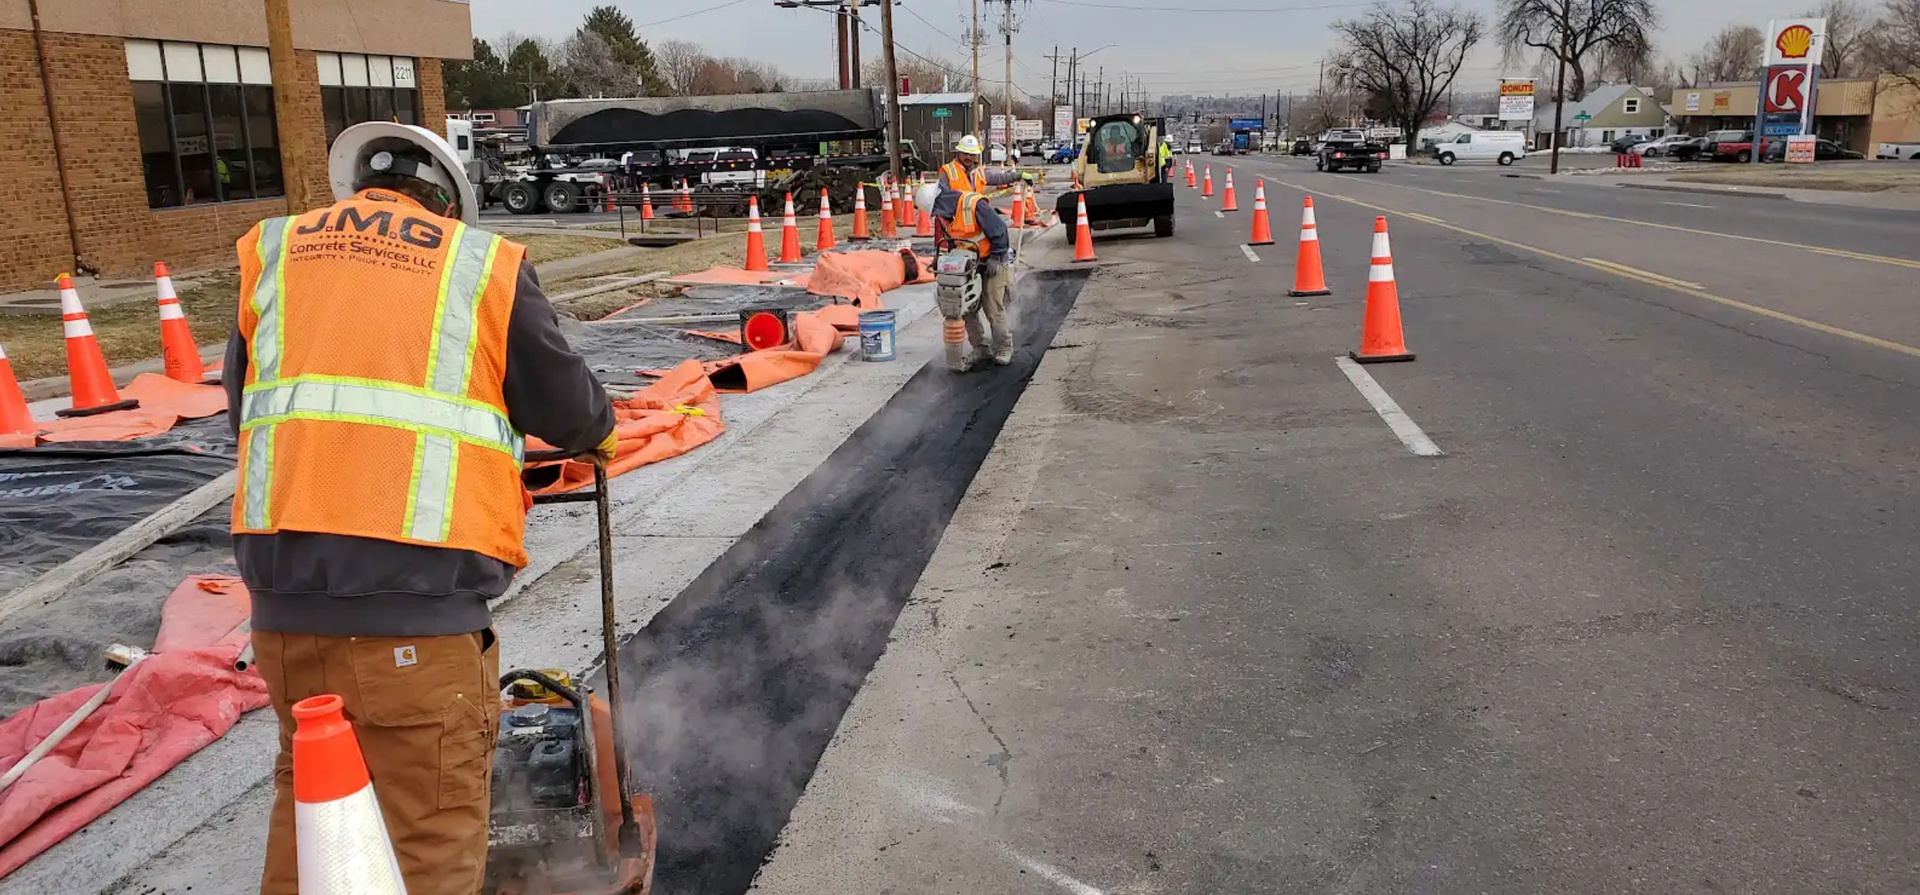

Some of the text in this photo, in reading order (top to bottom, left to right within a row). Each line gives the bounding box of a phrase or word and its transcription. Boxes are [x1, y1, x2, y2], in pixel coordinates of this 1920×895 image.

[395, 66, 411, 79] 2211
[1502, 84, 1533, 92] DONUTS
[1775, 73, 1806, 108] K
[296, 206, 444, 250] J.M.G
[289, 253, 433, 276] INTEGRITY PRIDE QUALITY
[290, 241, 437, 270] Concrete Services LLC
